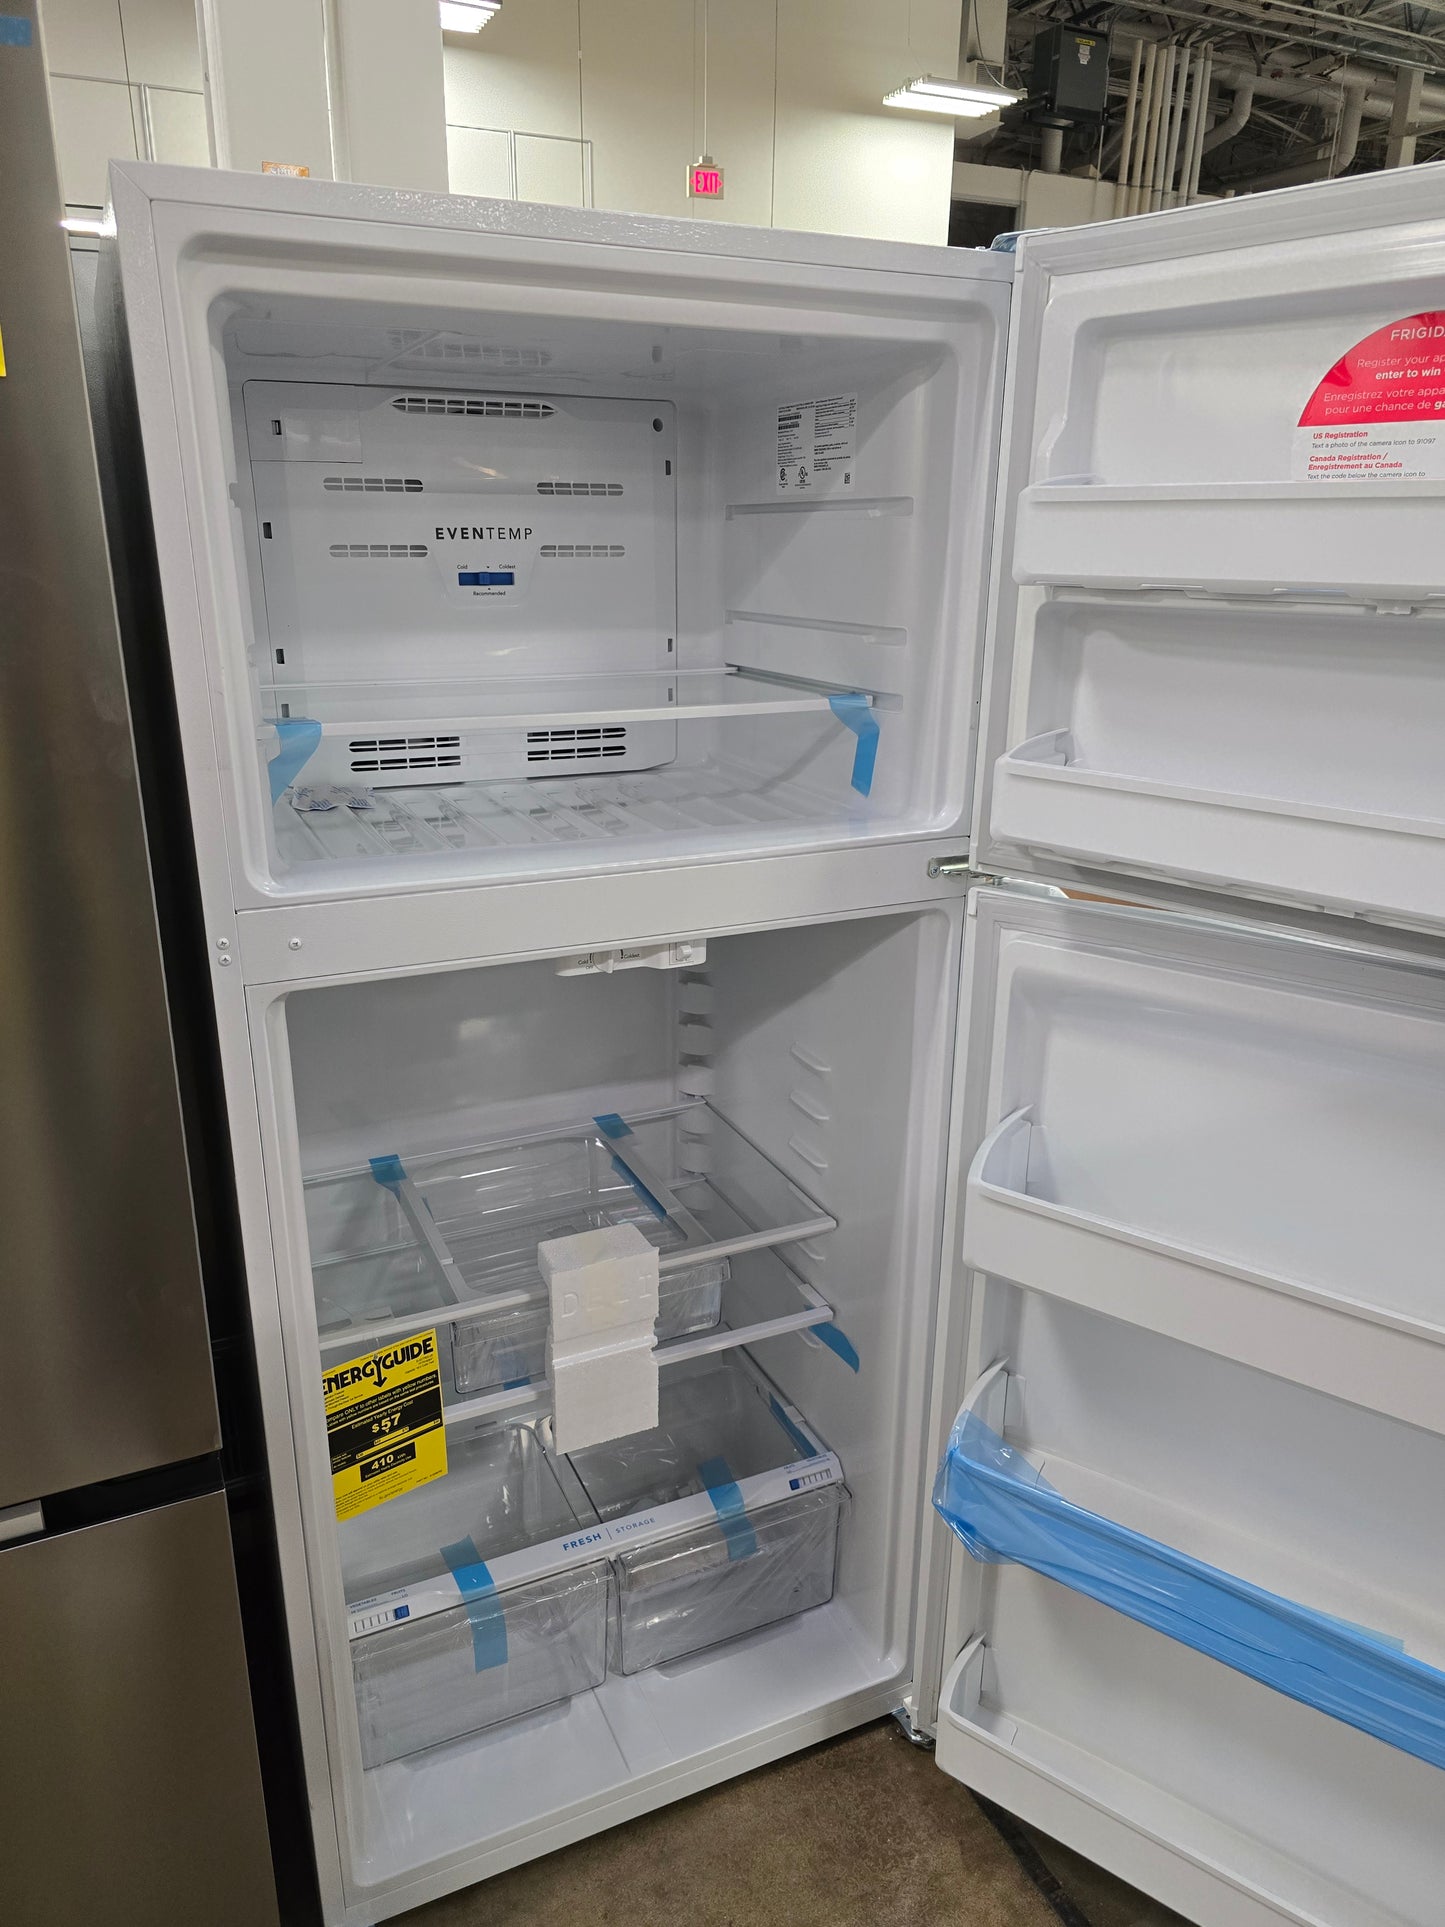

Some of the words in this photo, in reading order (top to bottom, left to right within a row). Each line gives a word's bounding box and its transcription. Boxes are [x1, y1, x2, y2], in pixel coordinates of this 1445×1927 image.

[695, 171, 719, 194] EXIT
[1391, 326, 1445, 341] FRIGID
[1357, 357, 1401, 369] Register
[1404, 356, 1430, 367] your
[1375, 370, 1404, 380] enter
[1407, 368, 1418, 378] to
[1421, 366, 1441, 377] win
[1323, 391, 1383, 403] Enregistrez
[1386, 388, 1415, 398] votre
[1325, 405, 1350, 415] pour
[1352, 405, 1372, 413] une
[1375, 402, 1414, 412] chance
[1417, 400, 1431, 410] de
[1313, 432, 1323, 440] US
[1324, 430, 1368, 440] Registration
[1330, 441, 1349, 449] photo
[1338, 453, 1382, 463] Registration
[1308, 462, 1362, 471] Enregistrement
[1375, 461, 1403, 469] Canada
[435, 527, 532, 540] EVENTEMP
[403, 1399, 414, 1408] Cost
[327, 1411, 344, 1423] ompare
[371, 1412, 401, 1434] $57
[371, 1454, 394, 1470] 410
[562, 1532, 602, 1551] FRESH
[615, 1517, 656, 1534] STORAGE
